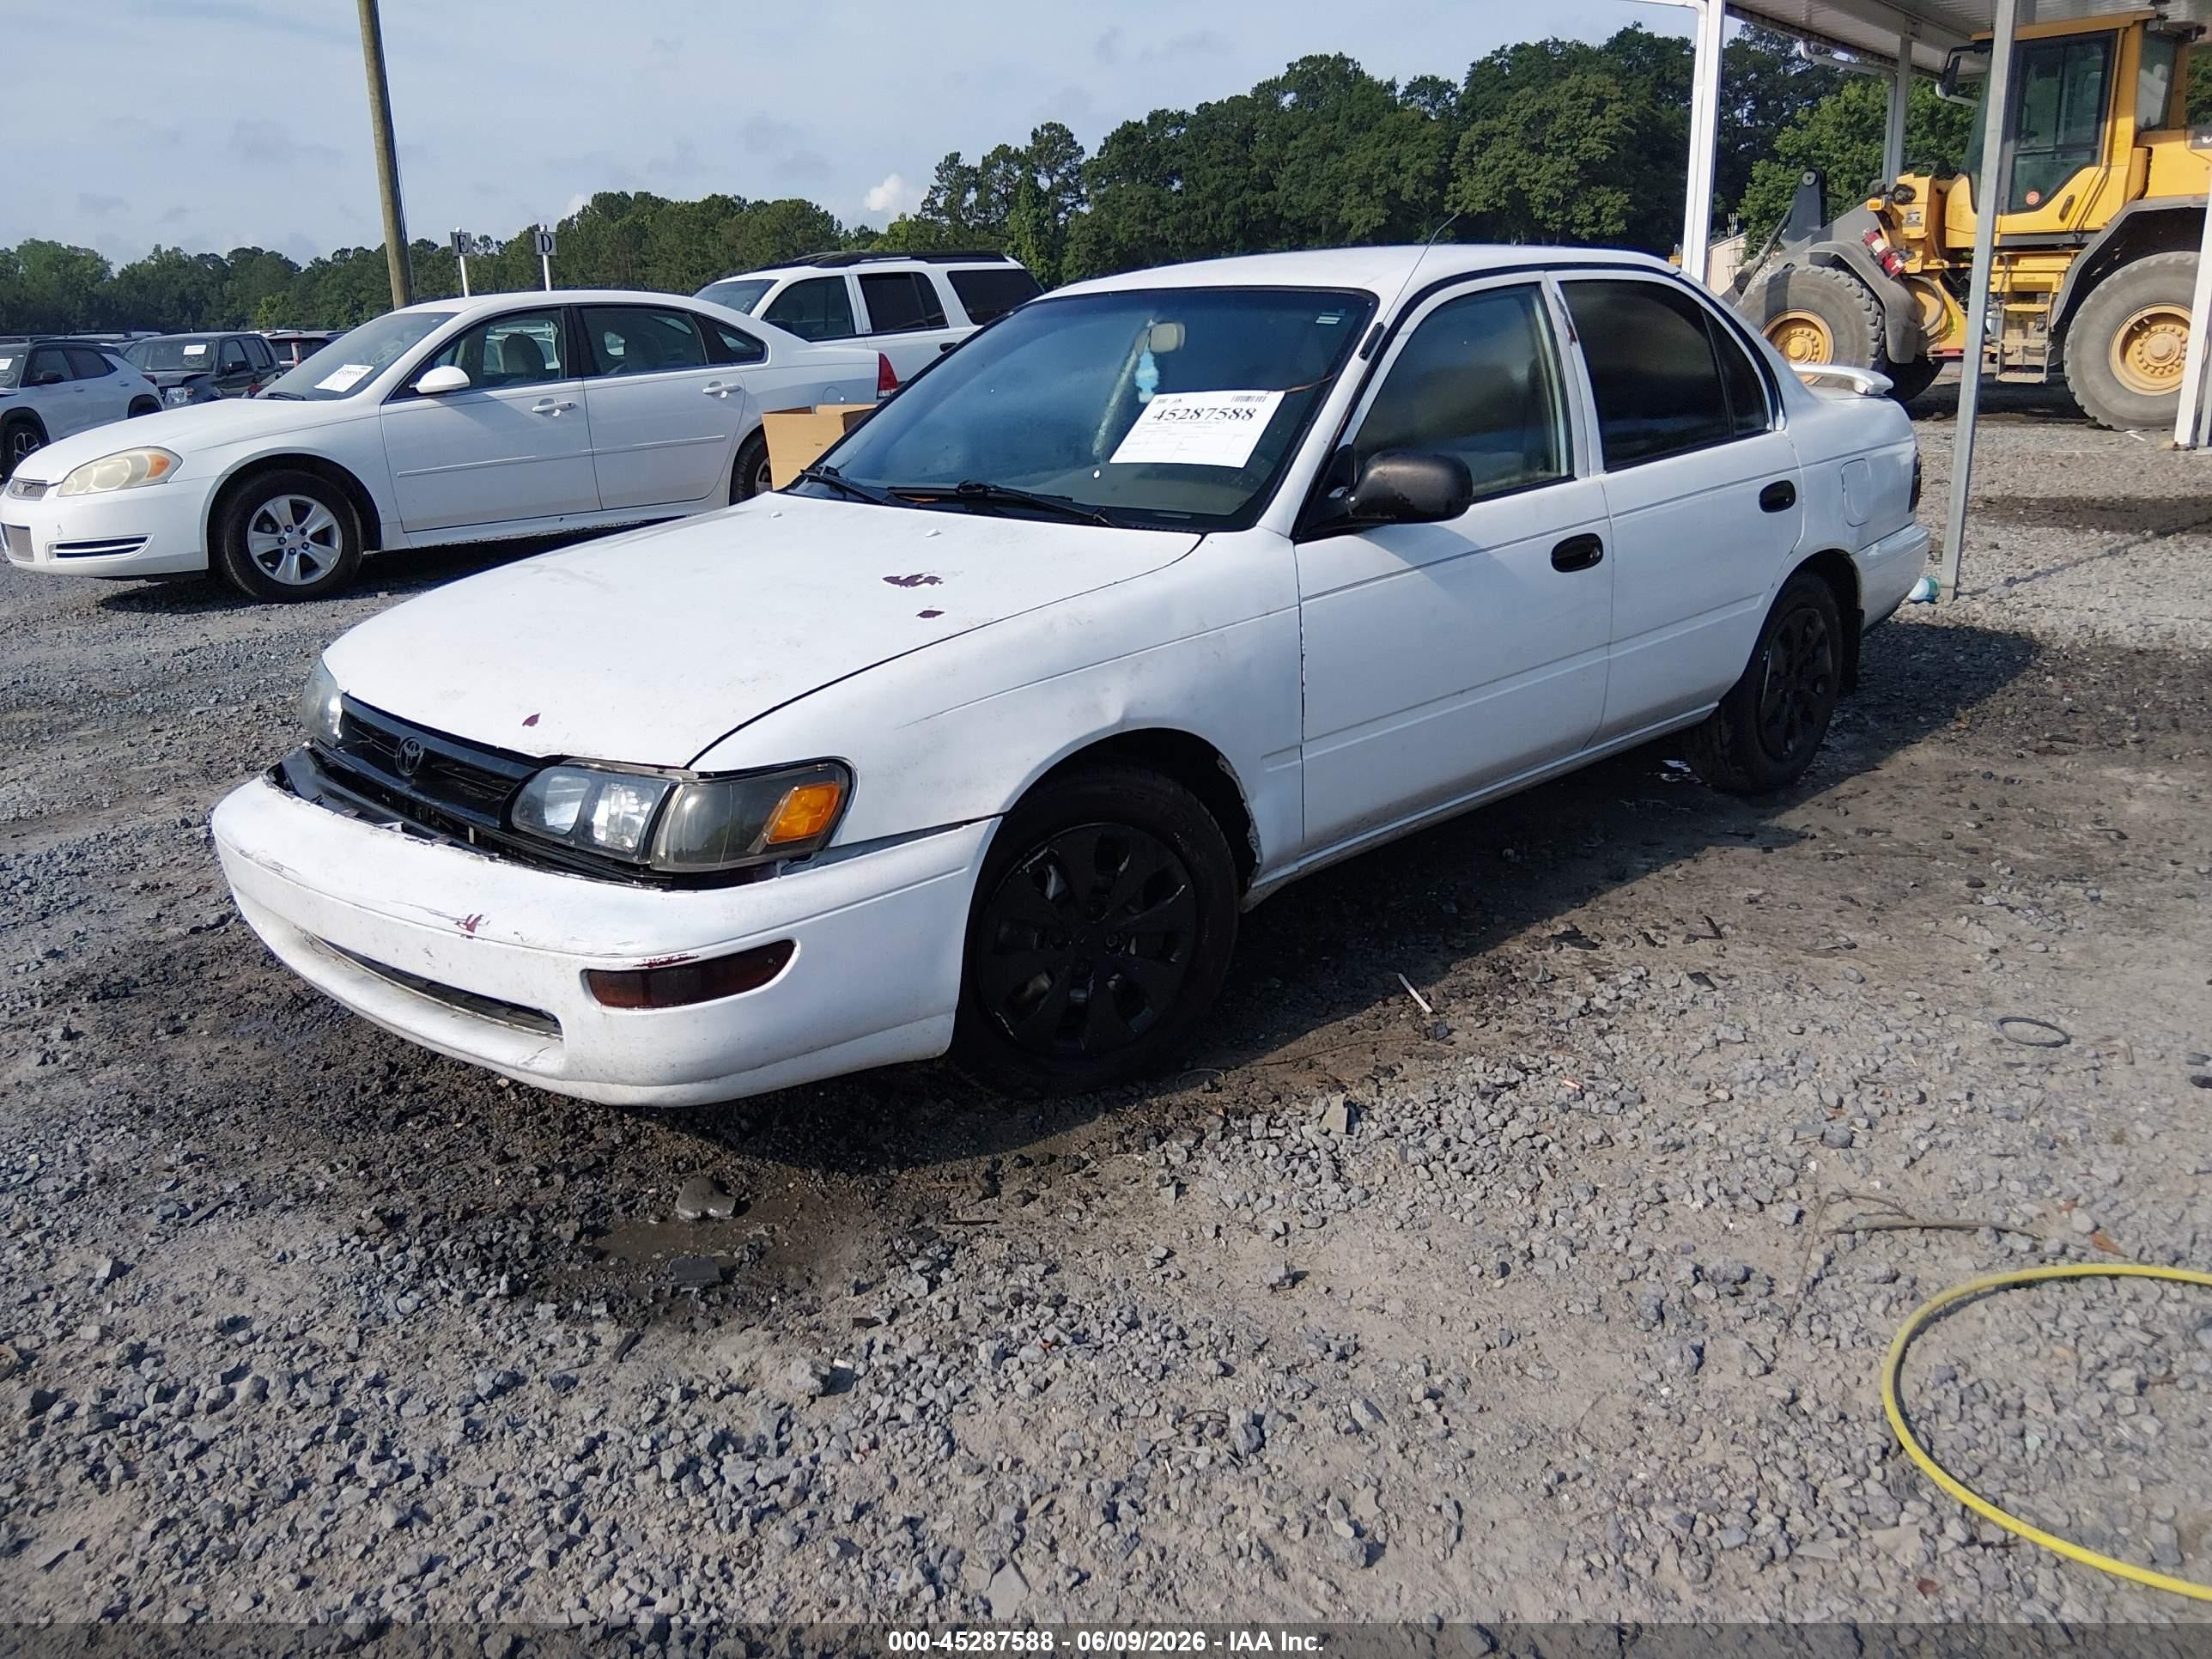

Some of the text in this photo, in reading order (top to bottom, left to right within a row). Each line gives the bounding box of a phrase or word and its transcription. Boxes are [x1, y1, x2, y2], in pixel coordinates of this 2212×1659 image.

[456, 234, 469, 253] E
[540, 234, 553, 252] D
[1152, 407, 1257, 421] 45287588
